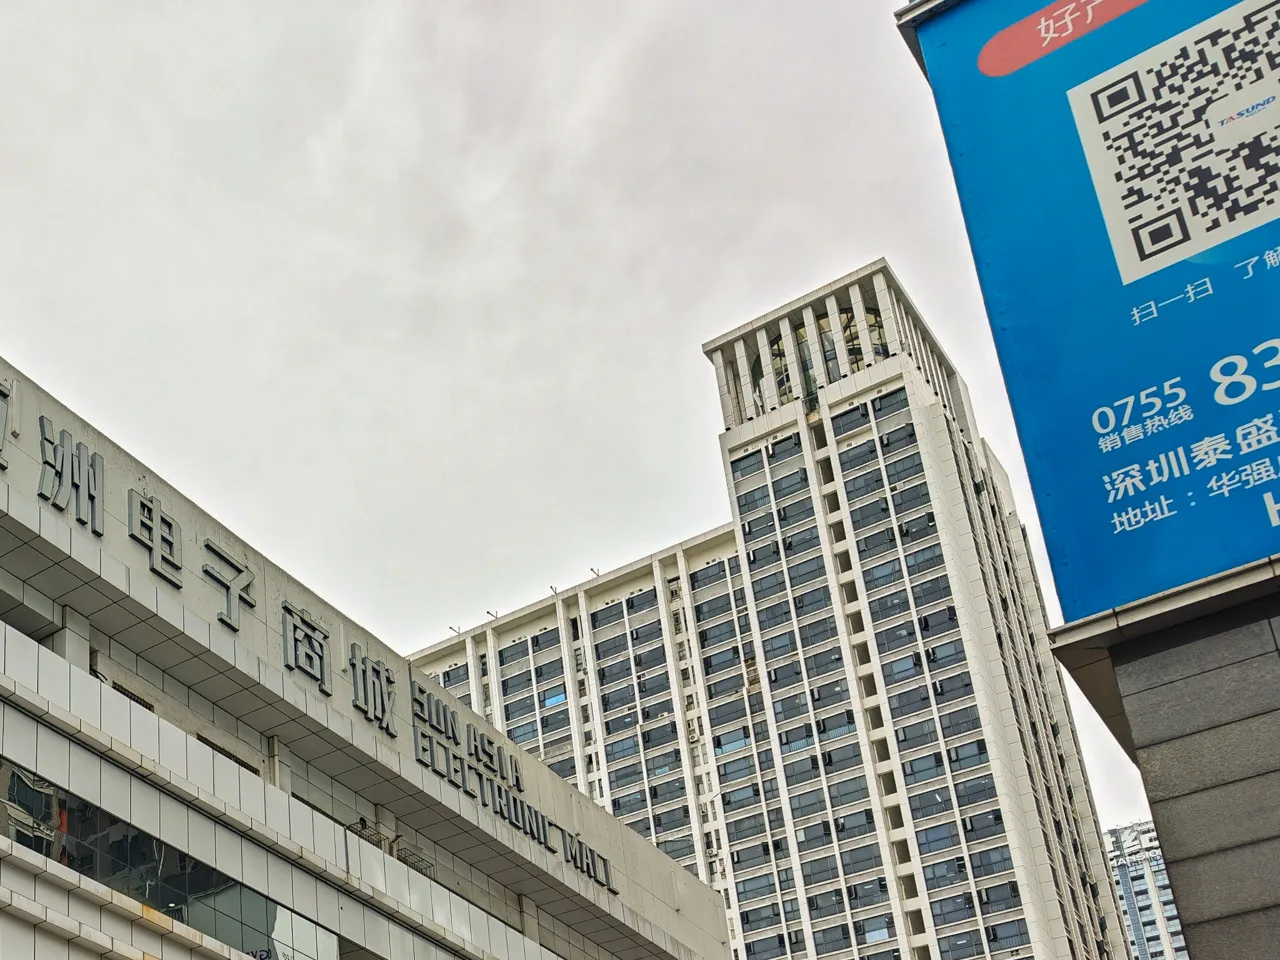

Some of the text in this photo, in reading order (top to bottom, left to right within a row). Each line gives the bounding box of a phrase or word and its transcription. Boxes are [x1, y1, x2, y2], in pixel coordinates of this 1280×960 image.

[1217, 95, 1277, 127] TASUND
[1130, 277, 1214, 326] 扫一扫
[1091, 376, 1187, 434] 0755
[1098, 404, 1194, 454] 销售热线
[1102, 413, 1280, 503] 深圳泰盛
[1111, 457, 1280, 534] 地址：华强
[412, 679, 524, 793] SUN ASIA
[414, 724, 620, 896] ELECTRONIC MALL
